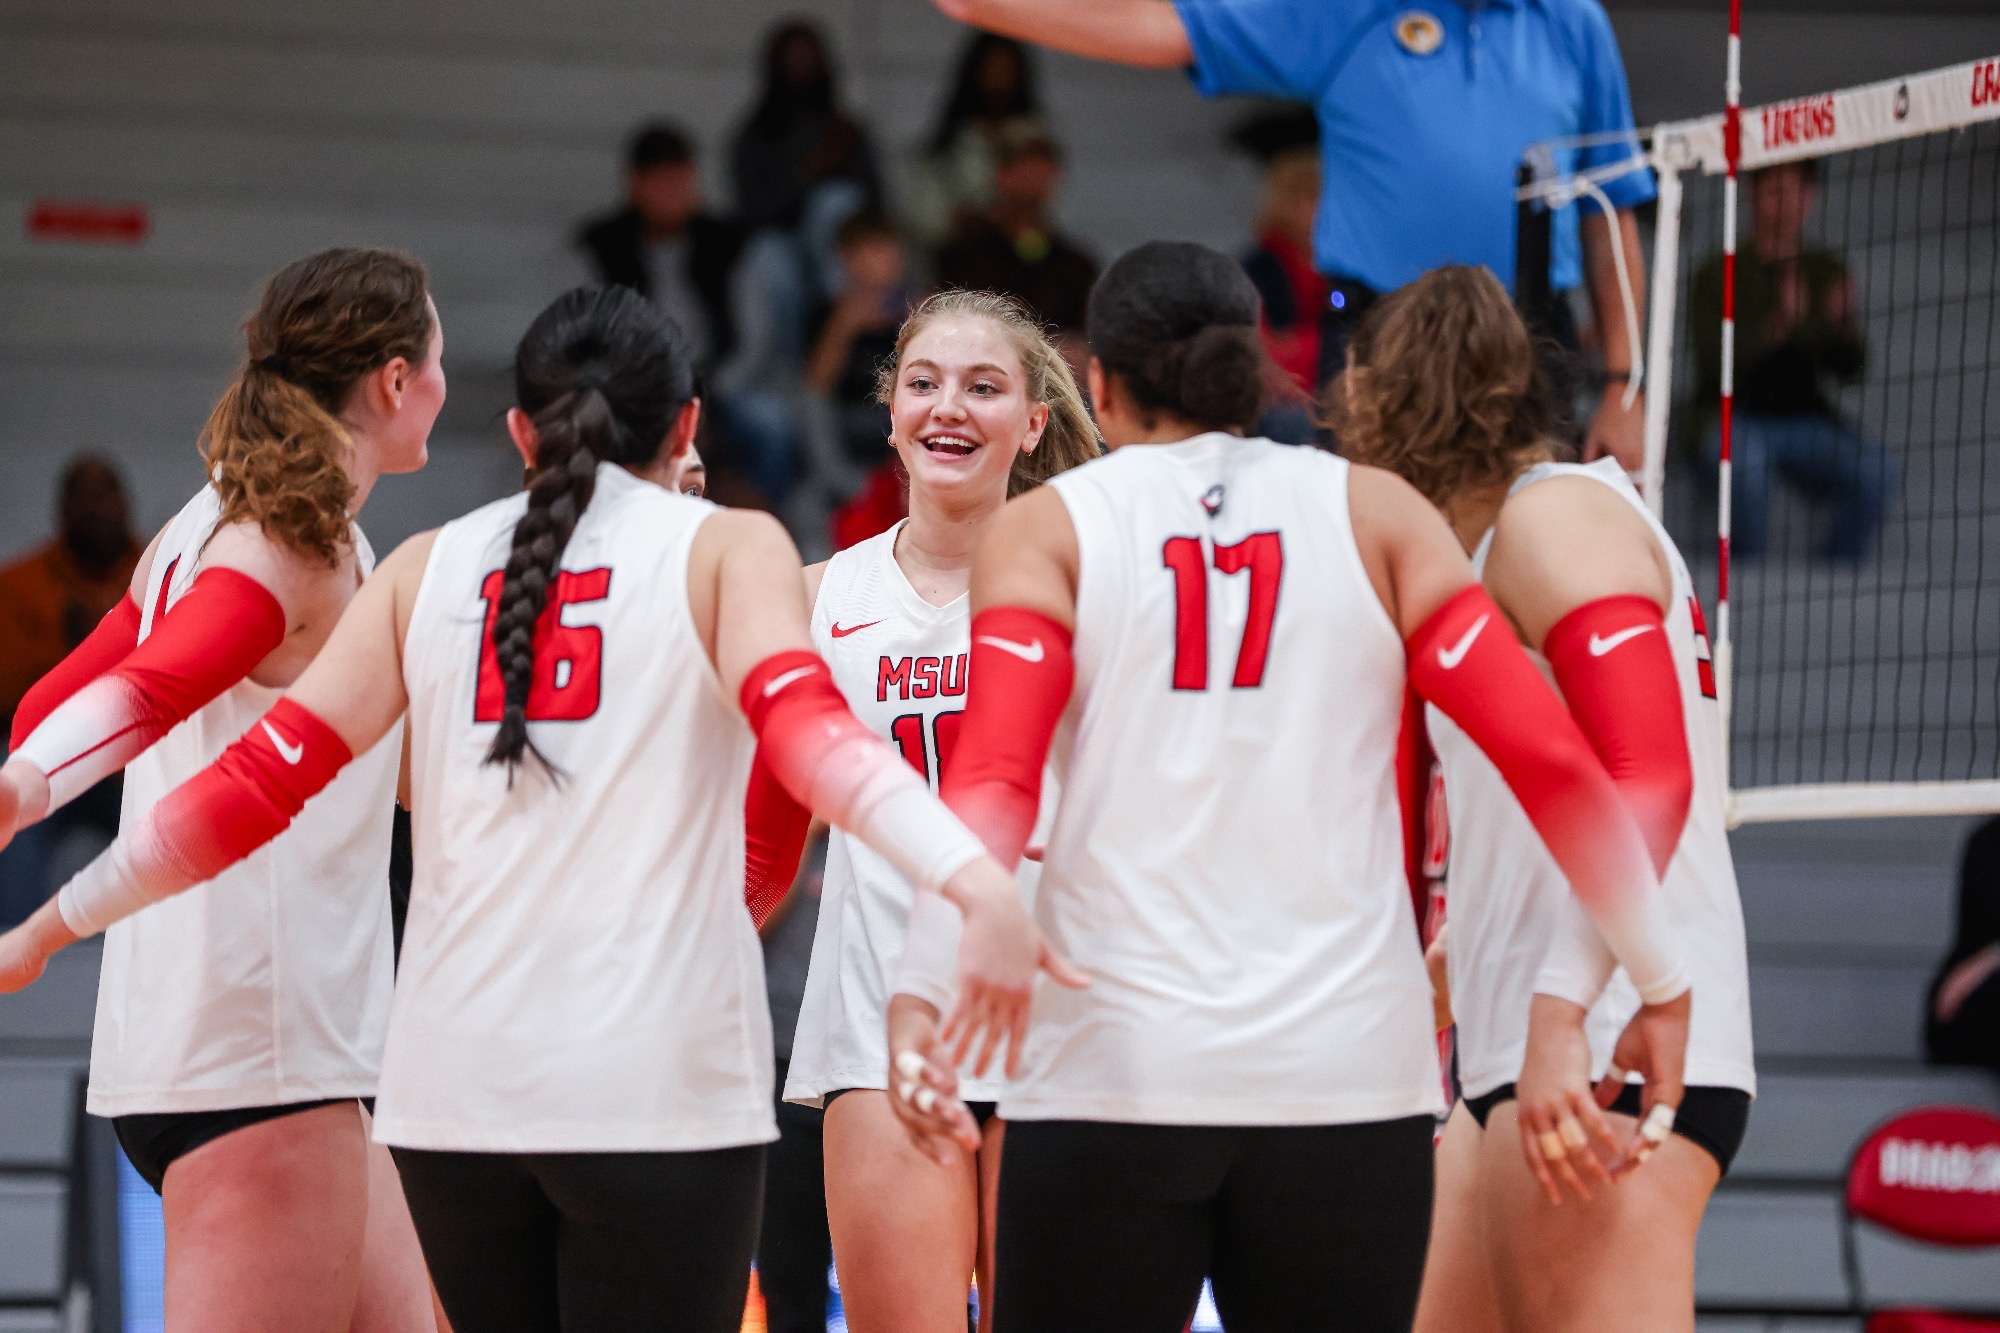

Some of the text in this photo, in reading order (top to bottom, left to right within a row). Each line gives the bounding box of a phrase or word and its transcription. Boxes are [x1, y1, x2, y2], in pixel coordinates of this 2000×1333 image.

[474, 567, 613, 724] 16
[876, 653, 968, 702] MSU
[1162, 529, 1284, 692] 17
